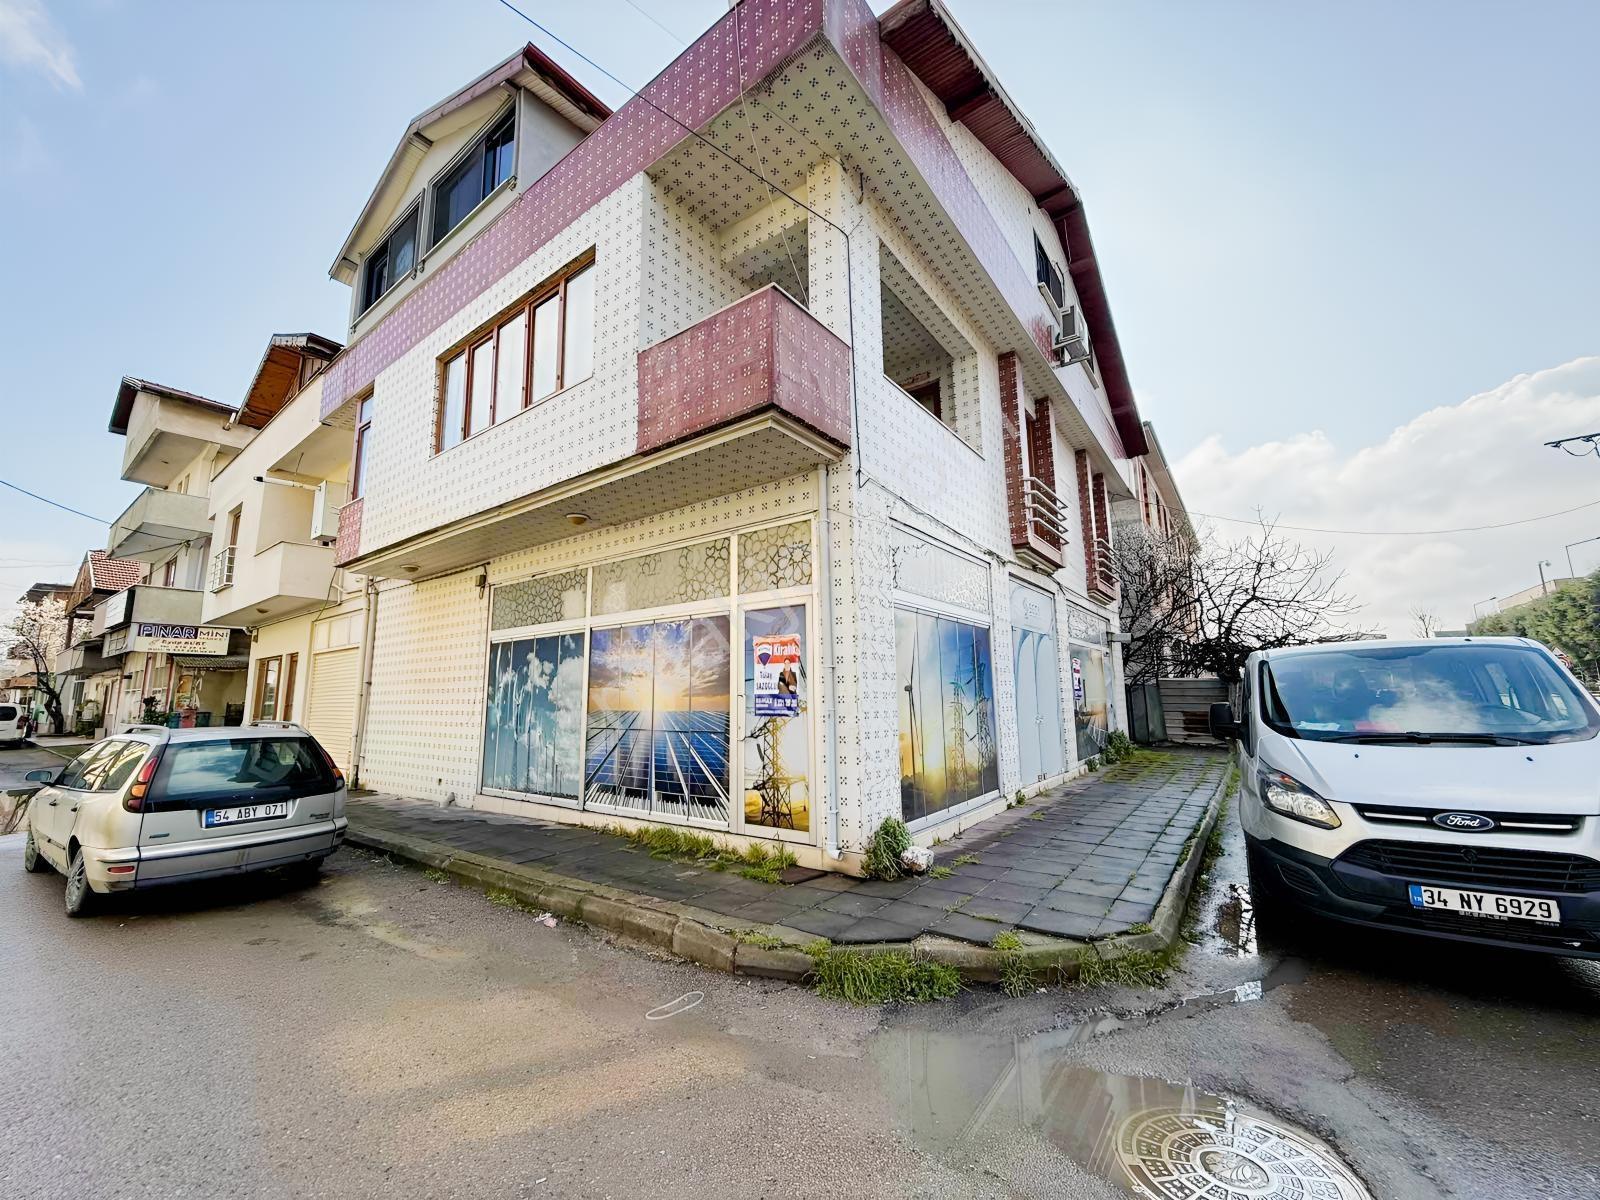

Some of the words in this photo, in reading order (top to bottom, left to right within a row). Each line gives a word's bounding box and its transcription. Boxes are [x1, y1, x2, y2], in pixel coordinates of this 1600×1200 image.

[141, 624, 195, 639] PINAR
[215, 810, 230, 822] 54
[237, 806, 258, 819] ABY
[264, 803, 285, 816] 071
[1446, 814, 1480, 827] Ford
[1423, 889, 1448, 908] 34
[1459, 892, 1484, 912] NY
[1495, 897, 1553, 919] 6929
